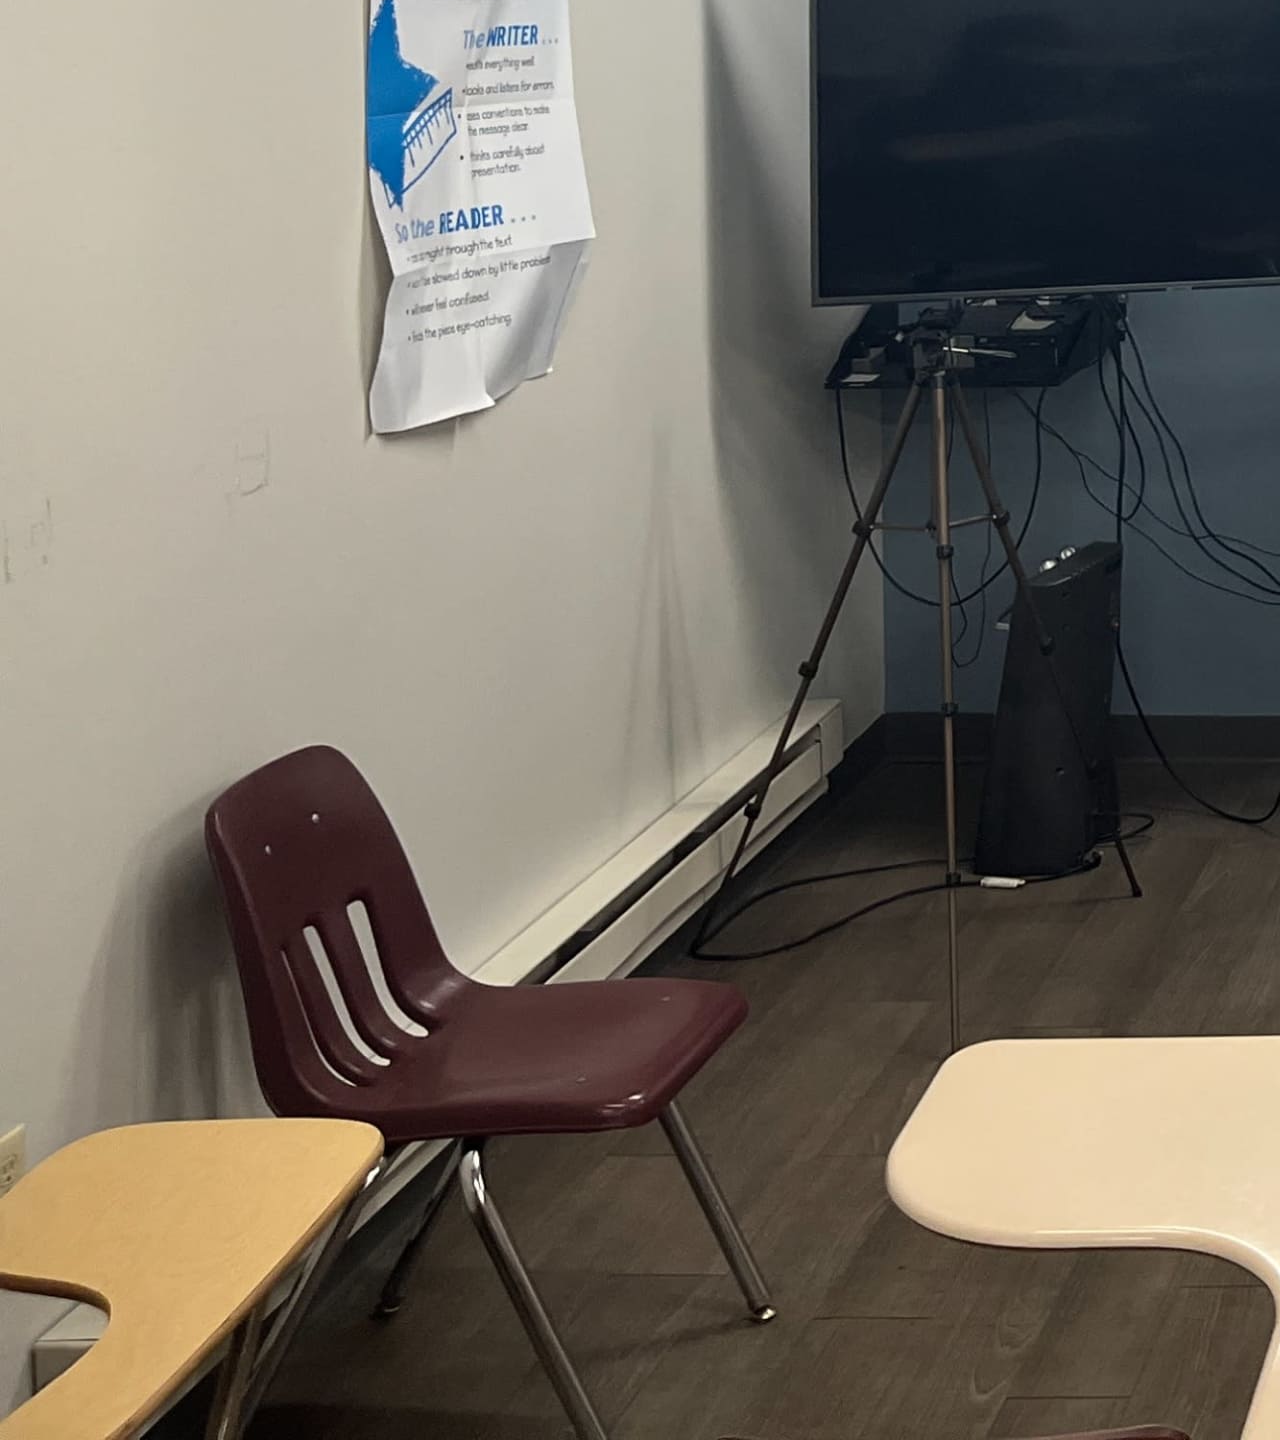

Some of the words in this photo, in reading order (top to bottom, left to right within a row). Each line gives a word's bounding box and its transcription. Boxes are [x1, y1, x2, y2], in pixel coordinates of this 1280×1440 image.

[463, 29, 485, 49] The
[486, 24, 538, 48] WRITER
[394, 221, 409, 244] So
[410, 218, 435, 240] the
[438, 204, 505, 235] READER
[461, 266, 488, 280] down
[488, 264, 499, 277] by
